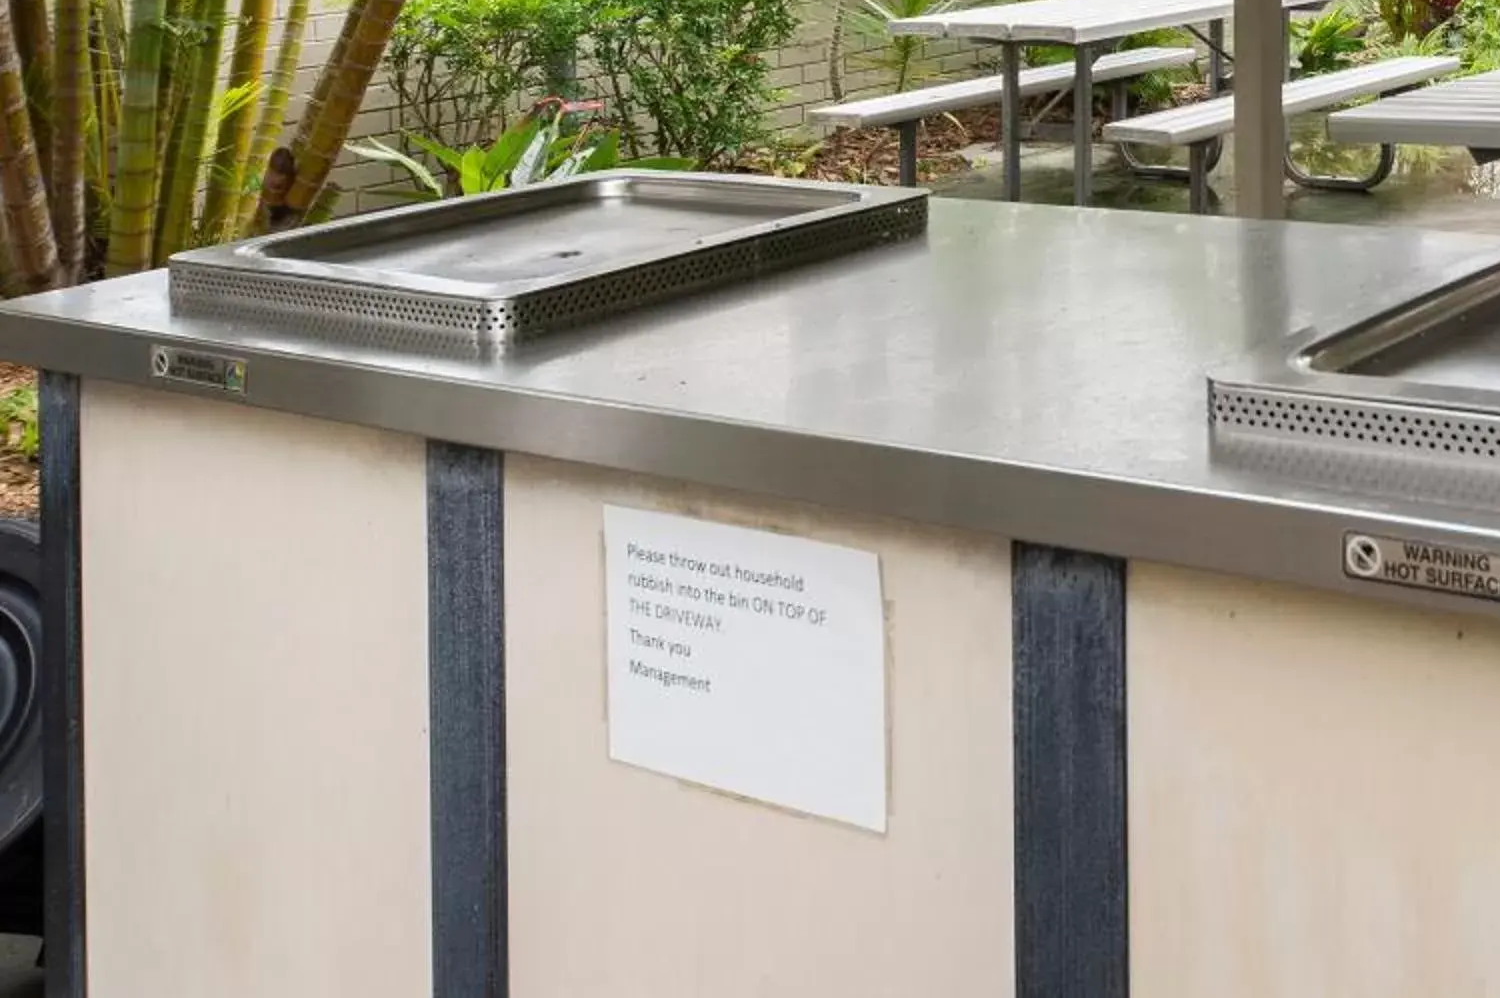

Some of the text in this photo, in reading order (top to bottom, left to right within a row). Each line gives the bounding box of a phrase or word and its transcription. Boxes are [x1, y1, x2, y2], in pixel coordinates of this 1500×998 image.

[627, 542, 805, 593] Please throw out household
[1384, 560, 1420, 581] HOT
[1403, 541, 1490, 572] WARNING
[628, 573, 828, 627] rubbish into the bin ON TOP OF
[629, 597, 651, 617] THE
[630, 627, 692, 659] Thank you
[630, 658, 711, 693] Management
